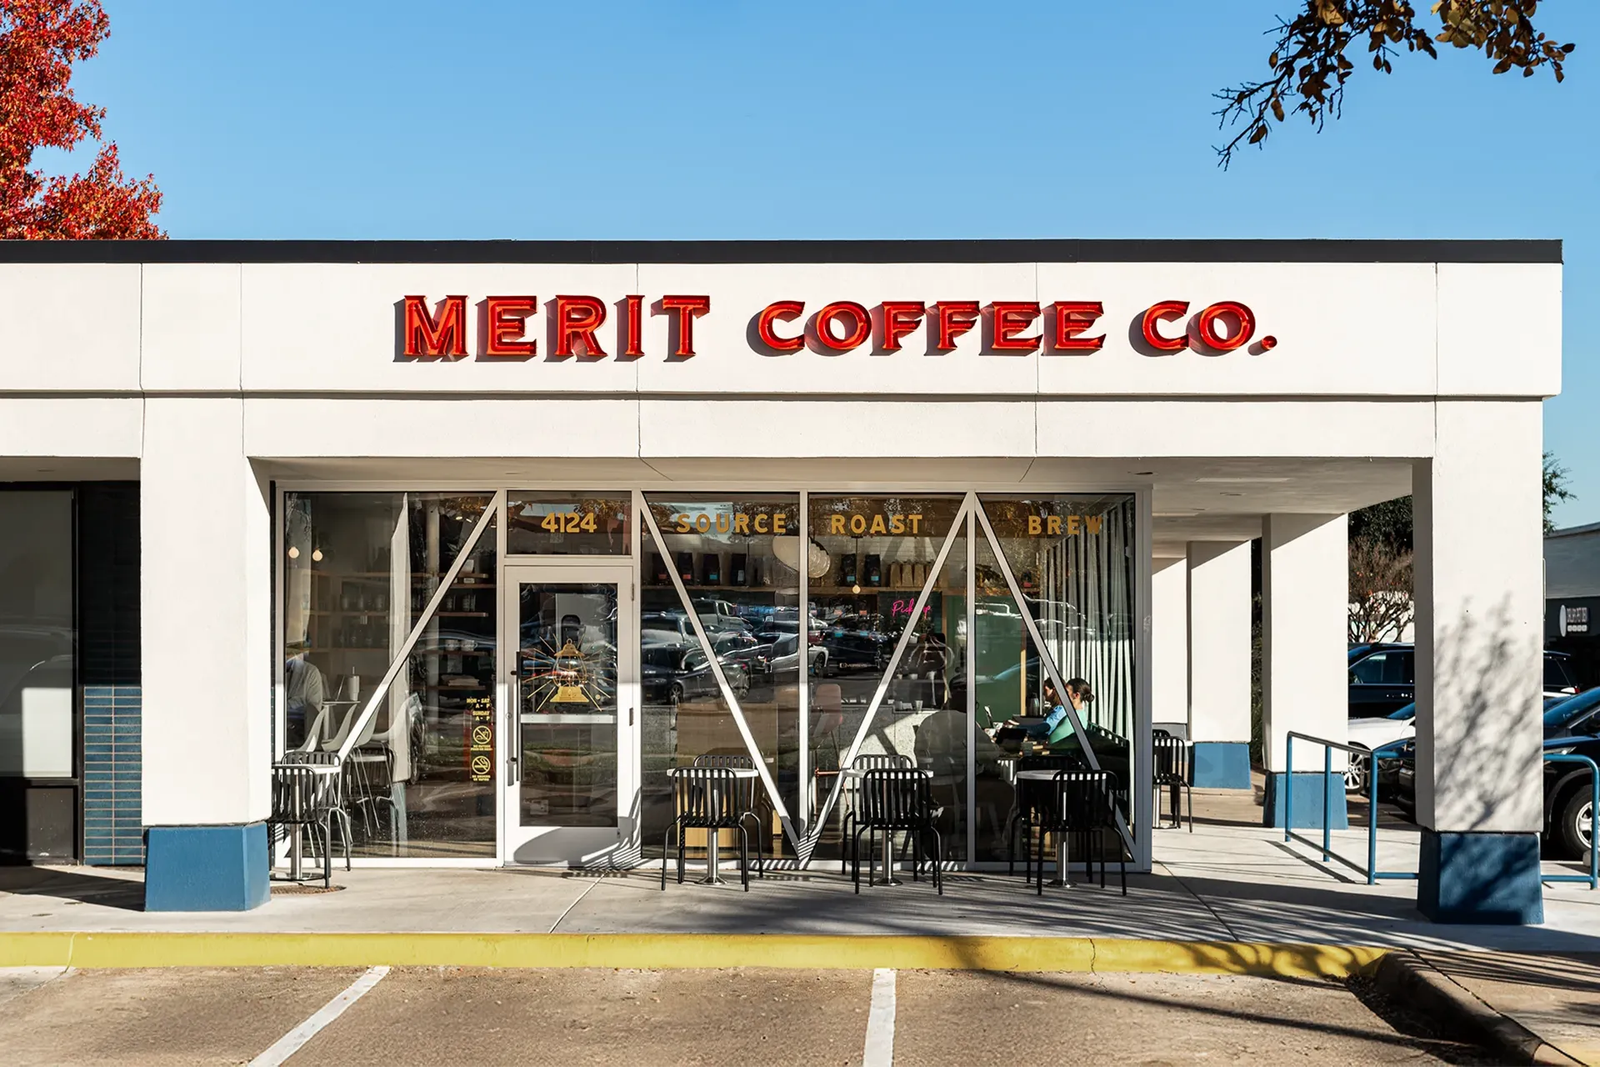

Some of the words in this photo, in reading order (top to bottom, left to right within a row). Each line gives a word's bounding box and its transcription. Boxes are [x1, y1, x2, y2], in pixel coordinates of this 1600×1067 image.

[403, 295, 710, 357] MERIT
[757, 300, 1105, 351] COFFEE
[1141, 300, 1278, 351] CO.
[541, 512, 597, 534] 4124
[676, 513, 787, 534] SOURCE
[830, 514, 923, 535] ROAST
[1028, 515, 1103, 536] BREW
